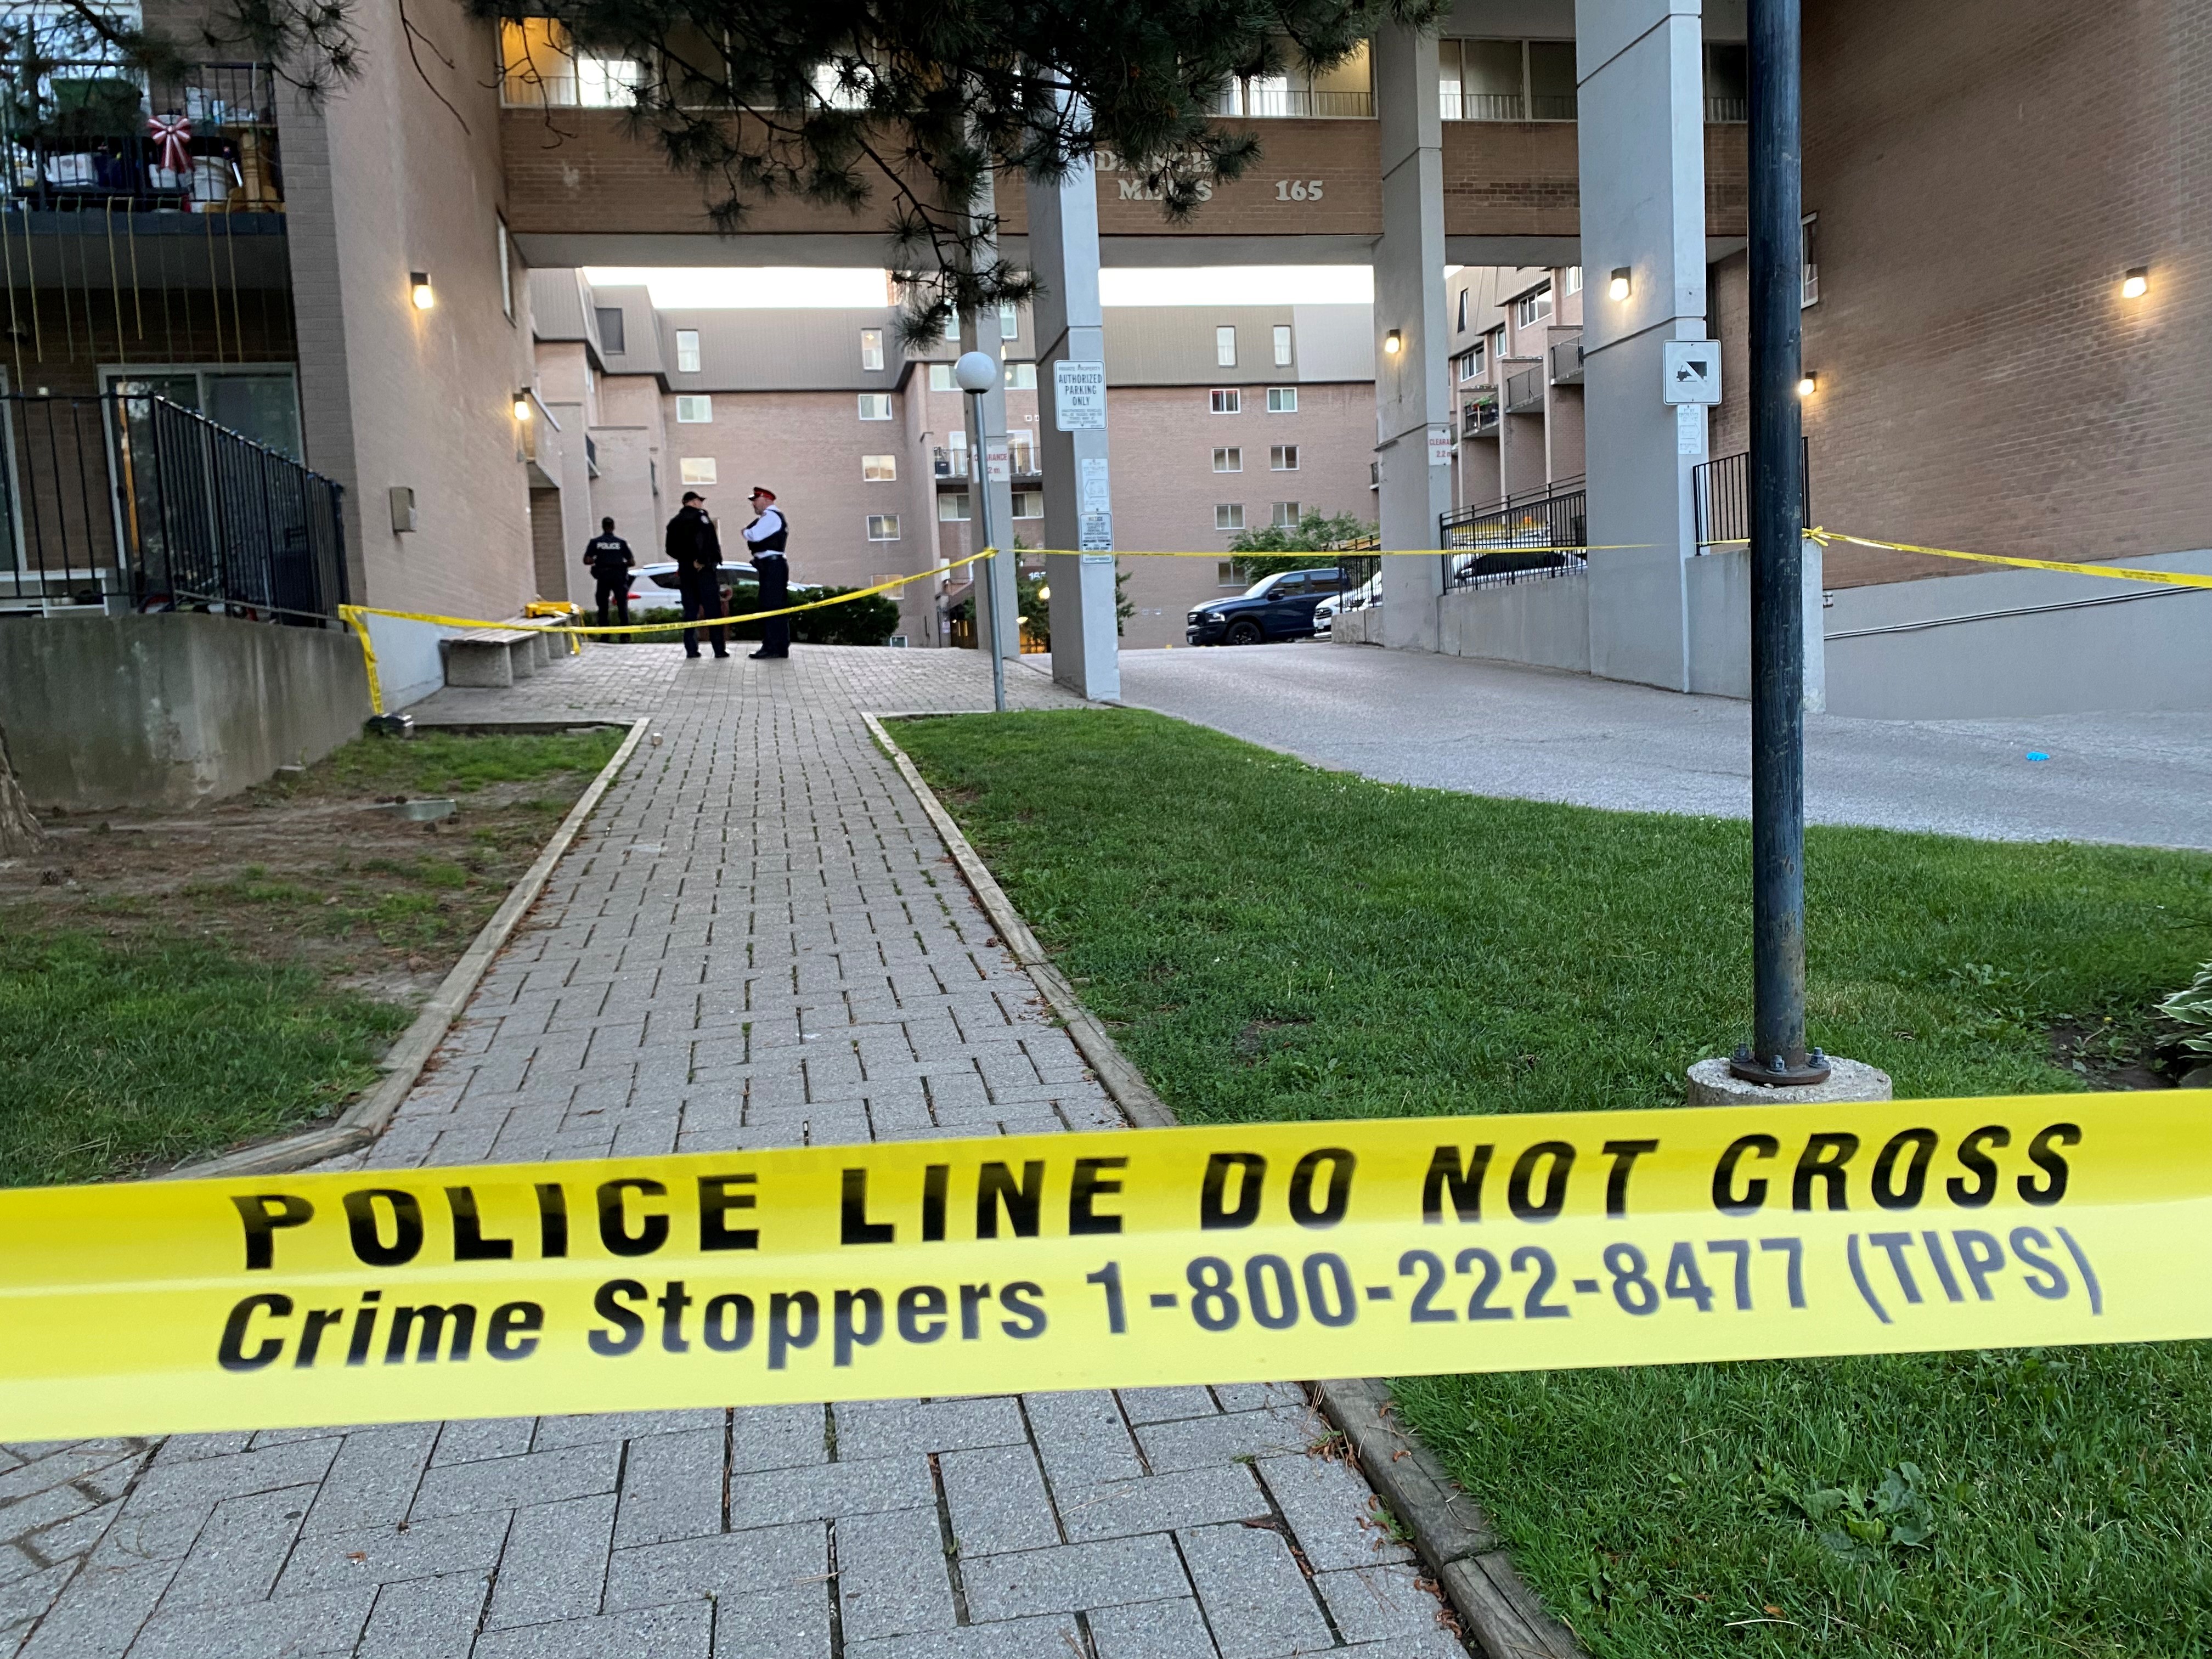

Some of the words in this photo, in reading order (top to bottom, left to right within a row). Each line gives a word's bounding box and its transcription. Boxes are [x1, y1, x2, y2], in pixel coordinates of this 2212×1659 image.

[1275, 180, 1323, 201] 165
[1059, 374, 1103, 384] AUTHORIZED
[1065, 385, 1097, 395] PARKING
[1072, 396, 1090, 406] ONLY
[596, 541, 620, 550] POLICE
[230, 1173, 759, 1270] POLICE
[840, 1156, 1130, 1245] LINE
[1200, 1147, 1357, 1231] DO
[1421, 1138, 1661, 1224] NOT
[1712, 1122, 2083, 1216] CROSS
[218, 1289, 545, 1373] Crime
[588, 1278, 1048, 1370] Stoppers
[1086, 1237, 1808, 1335] 1-800-222-8477
[1847, 1226, 2103, 1324] (TIPS)
